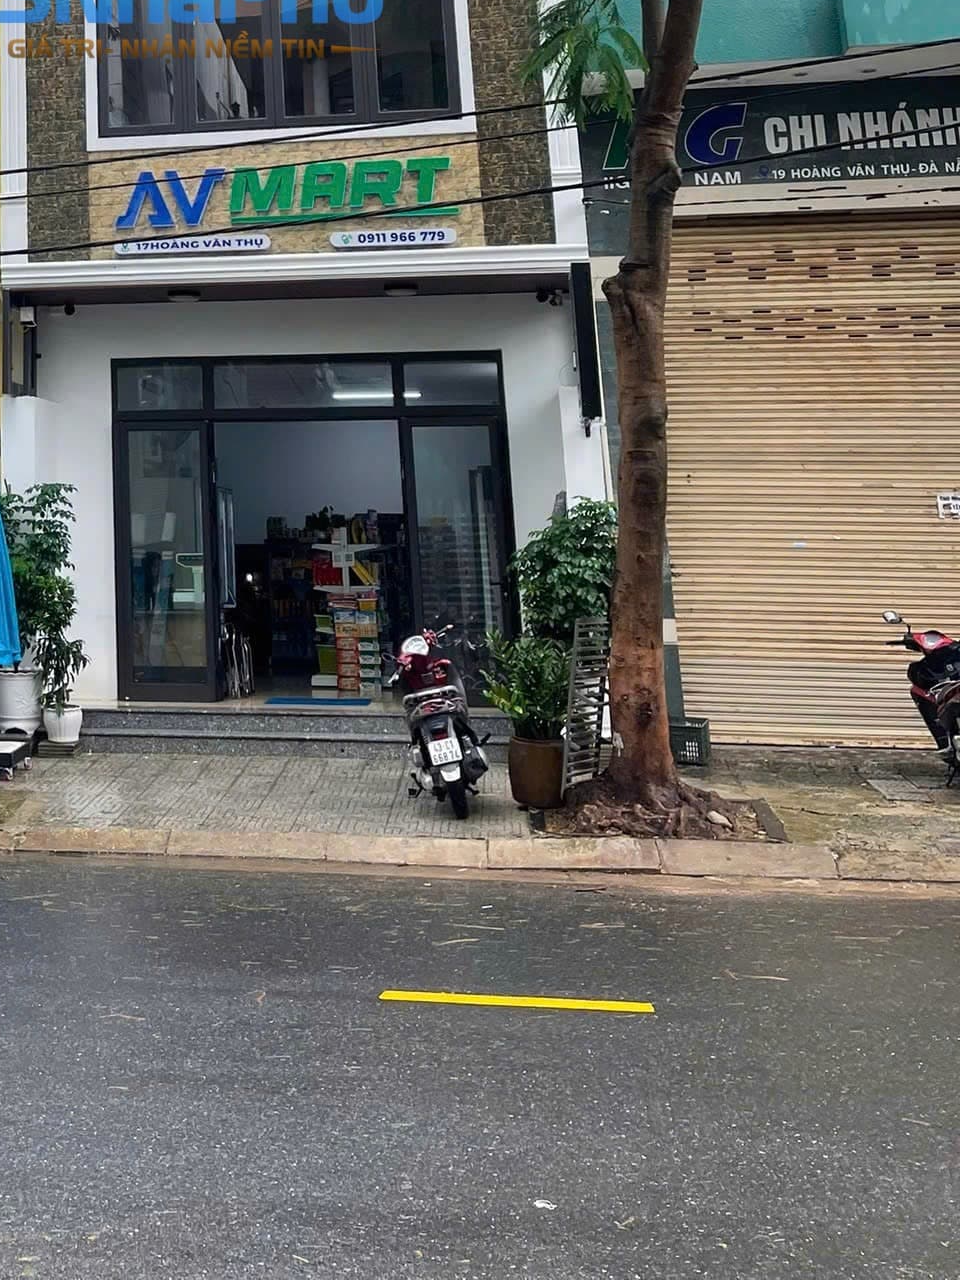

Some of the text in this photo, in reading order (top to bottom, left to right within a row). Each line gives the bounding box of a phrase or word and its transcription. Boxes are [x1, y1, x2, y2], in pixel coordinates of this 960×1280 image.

[763, 113, 827, 154] CHI
[694, 171, 741, 185] NAM
[772, 170, 785, 180] 19
[791, 165, 841, 179] HOÀNG
[847, 163, 875, 177] VĂN
[115, 156, 451, 229] AV MART
[235, 238, 264, 248] THỤ
[358, 231, 445, 244] 0911 966 779
